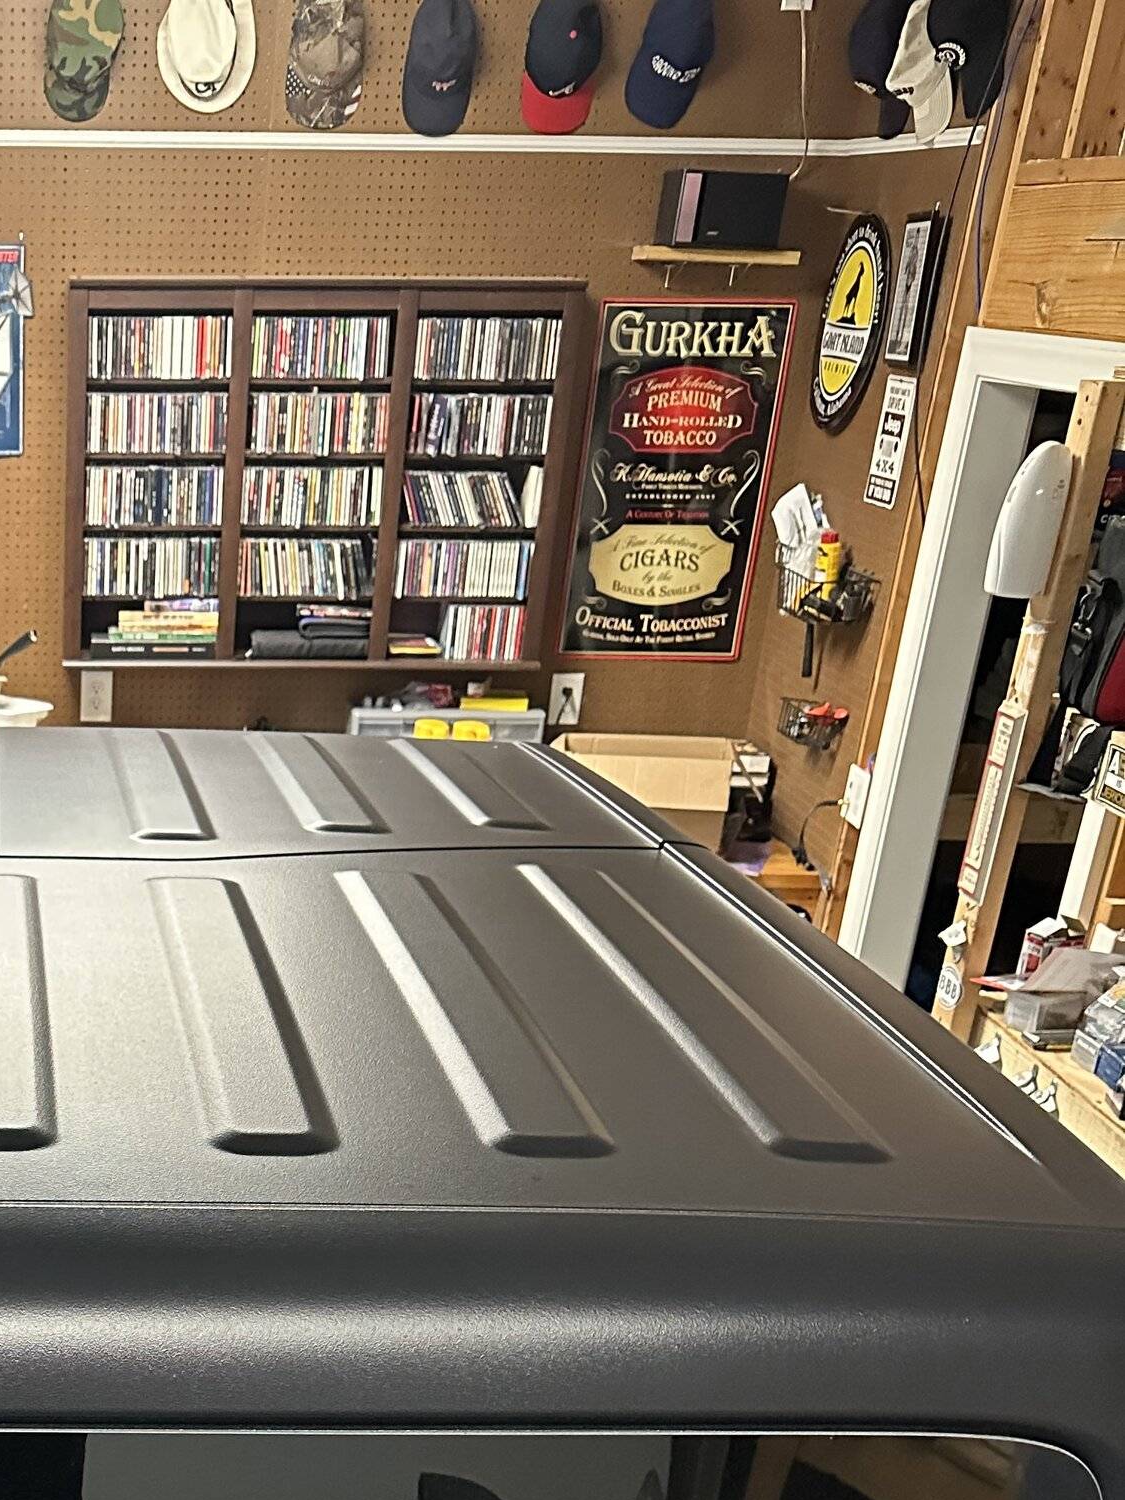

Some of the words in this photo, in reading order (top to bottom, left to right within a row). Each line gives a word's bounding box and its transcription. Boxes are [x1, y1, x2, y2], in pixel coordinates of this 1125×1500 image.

[610, 310, 777, 360] GURKHA
[823, 331, 842, 351] GOAT
[841, 335, 865, 355] ISLAND
[823, 361, 851, 375] BREWING
[646, 389, 722, 413] PREMIUM
[622, 412, 743, 429] HAND-ROLLED
[884, 414, 902, 436] Jeep
[643, 430, 717, 446] TOBACCO
[619, 548, 700, 572] CIGARS
[642, 570, 654, 583] by
[646, 586, 656, 597] &
[575, 605, 635, 632] OFFICIAL
[640, 612, 729, 633] TOBACCONIST
[938, 974, 958, 1000] BBB
